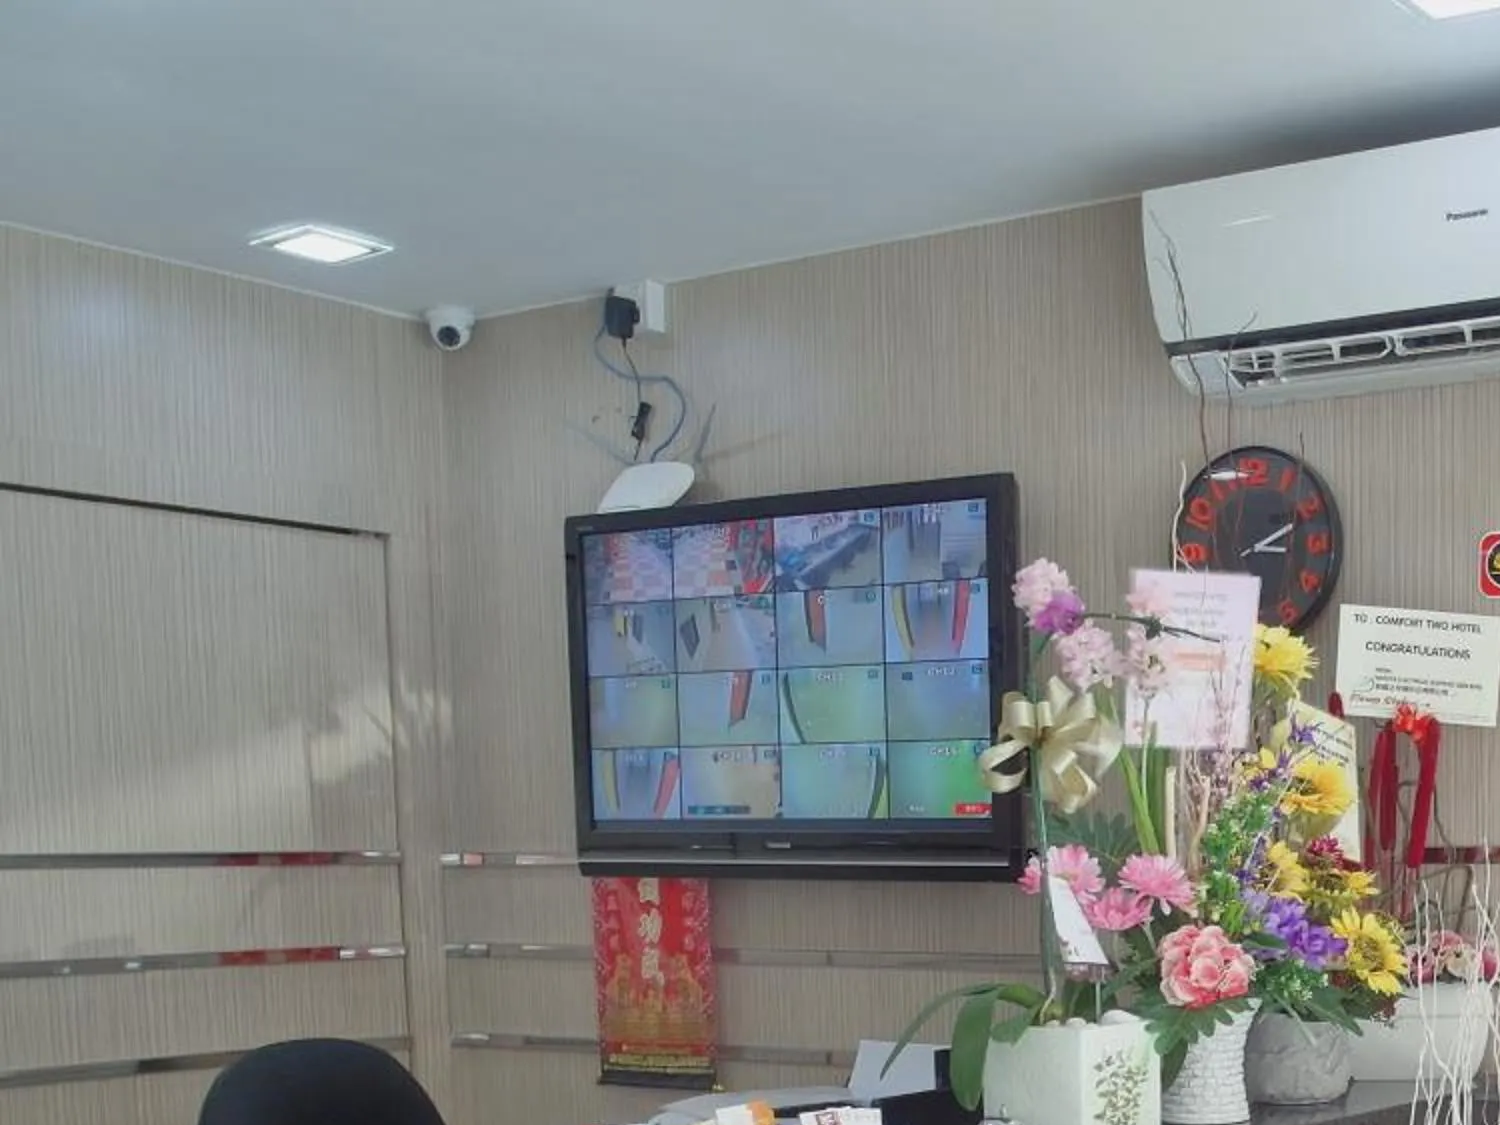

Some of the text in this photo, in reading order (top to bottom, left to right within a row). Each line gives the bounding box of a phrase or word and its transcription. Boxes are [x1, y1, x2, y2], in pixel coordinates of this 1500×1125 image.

[1375, 614, 1423, 629] COMFORT
[1427, 619, 1448, 631] TWO
[1451, 622, 1481, 634] HOTEL
[1365, 641, 1471, 660] CONGRATULATIONS
